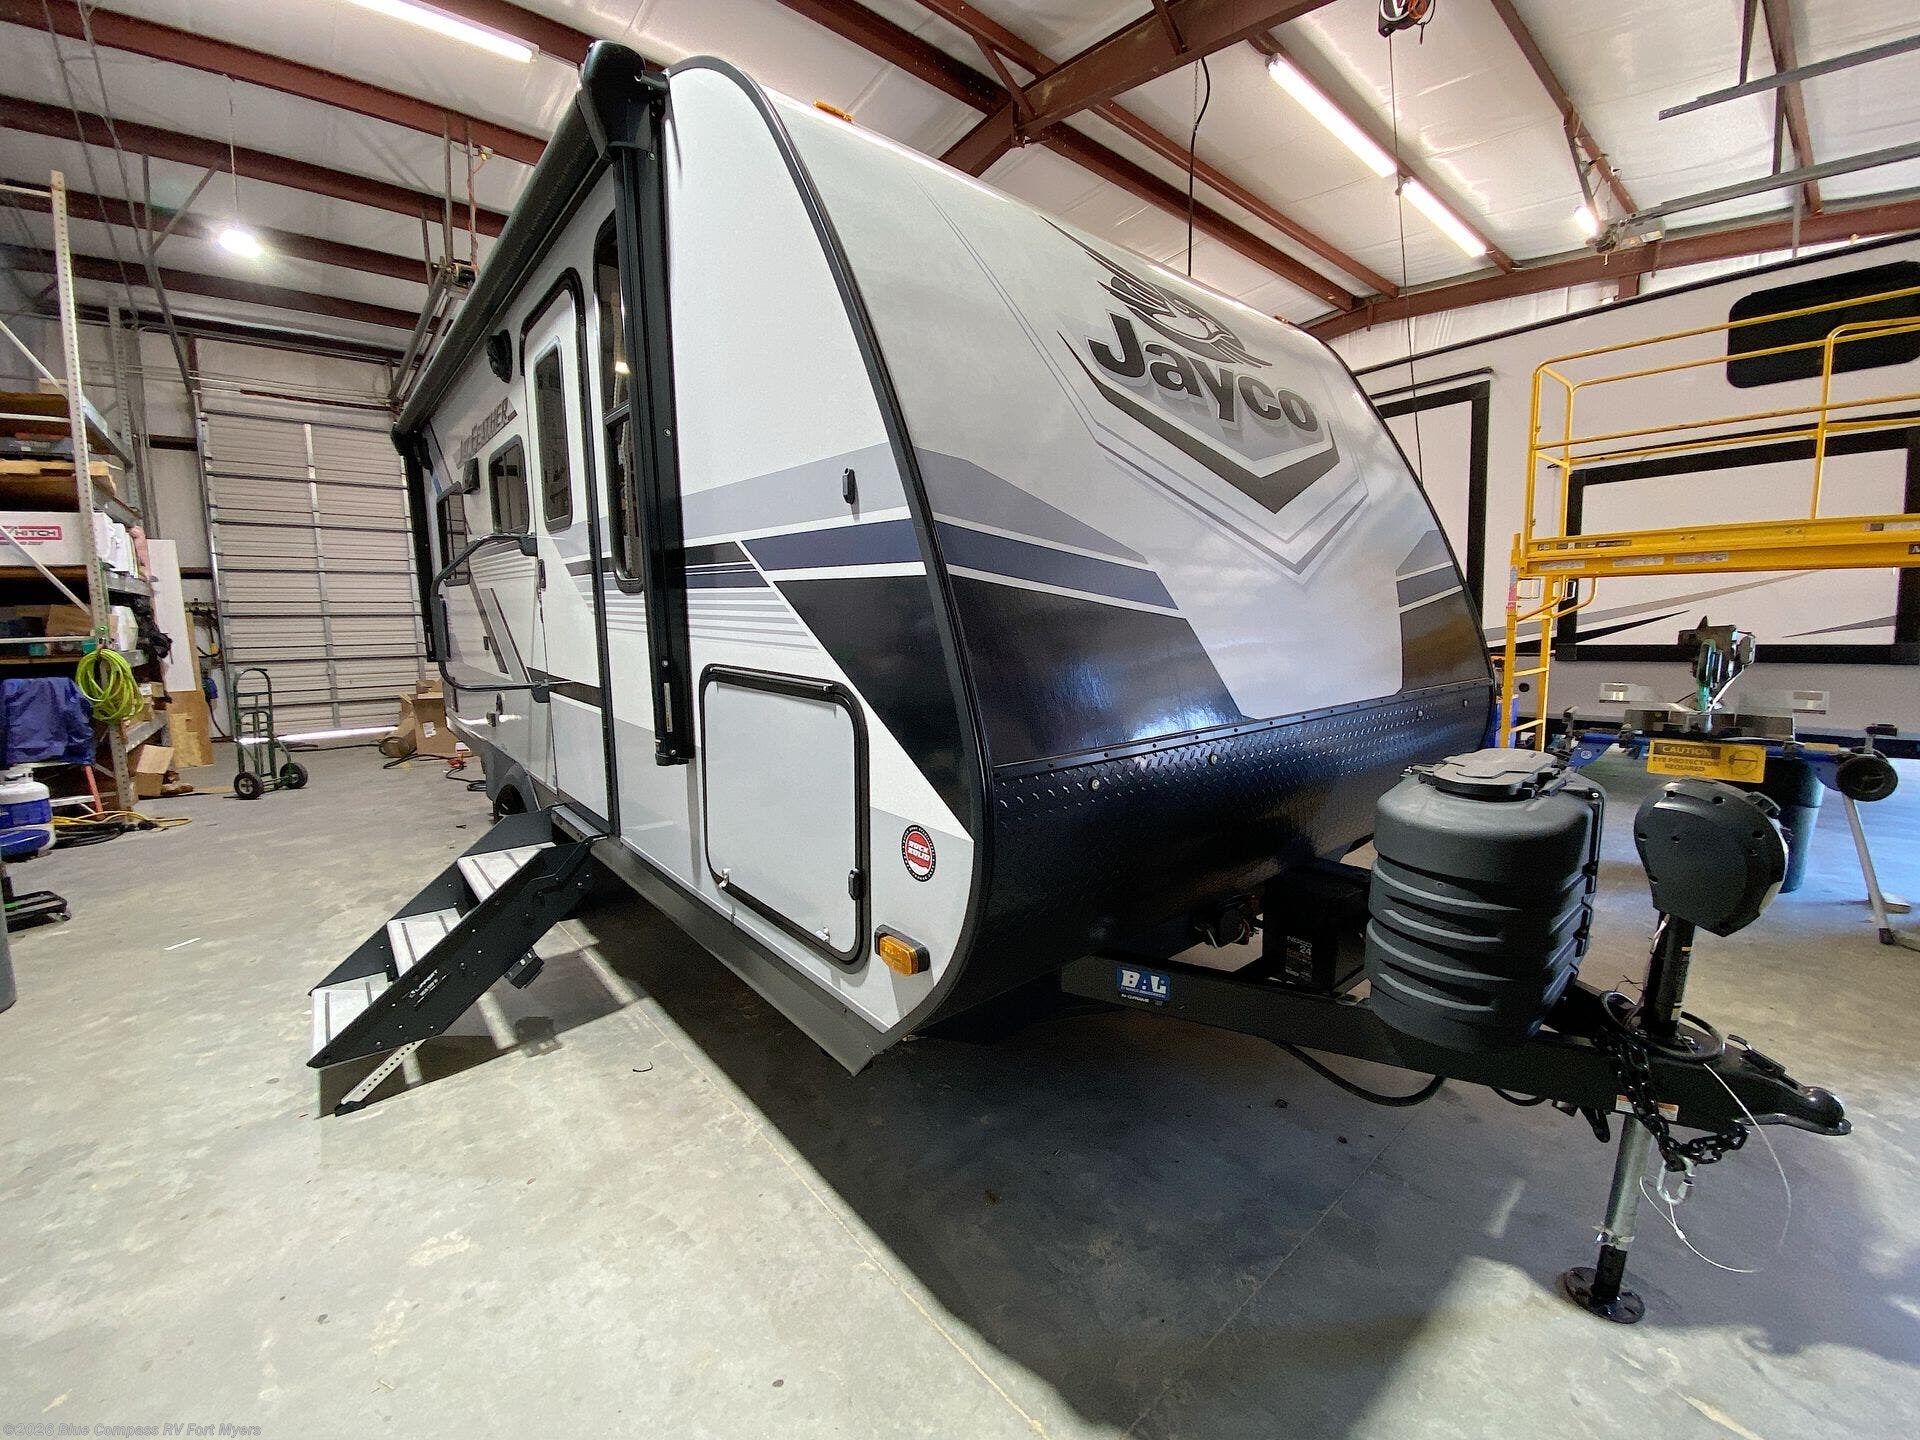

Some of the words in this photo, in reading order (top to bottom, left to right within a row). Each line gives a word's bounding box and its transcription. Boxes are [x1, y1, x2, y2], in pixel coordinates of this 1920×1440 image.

[1087, 311, 1318, 432] Jayco
[1662, 745, 1712, 756] CAUTION
[1668, 757, 1720, 767] PROTECTION
